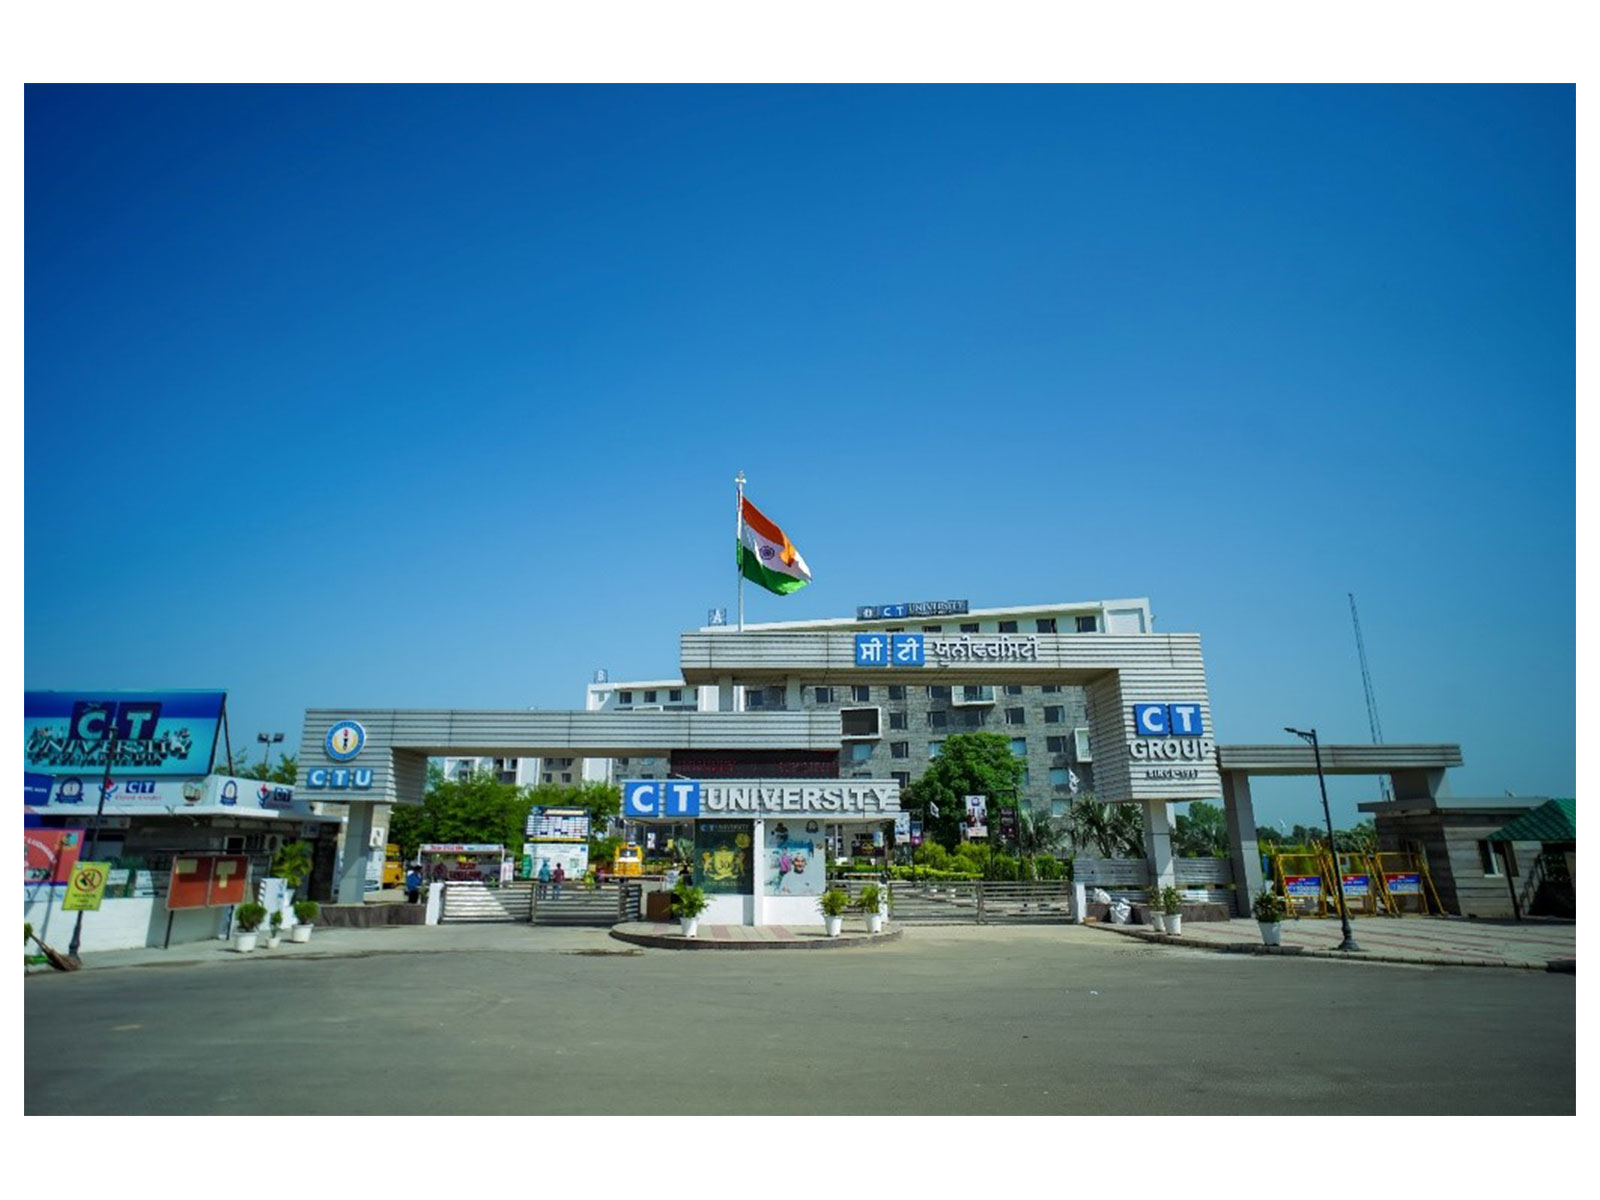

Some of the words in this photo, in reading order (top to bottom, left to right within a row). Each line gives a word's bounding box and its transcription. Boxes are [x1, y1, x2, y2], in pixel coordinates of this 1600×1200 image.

[712, 609, 723, 624] A
[859, 637, 883, 661] ਸੀ
[896, 637, 920, 661] ਟੀ
[1142, 706, 1195, 732] CT
[1130, 739, 1217, 759] GROUP
[631, 785, 694, 812] CT
[706, 787, 892, 811] UNIVERSITY
